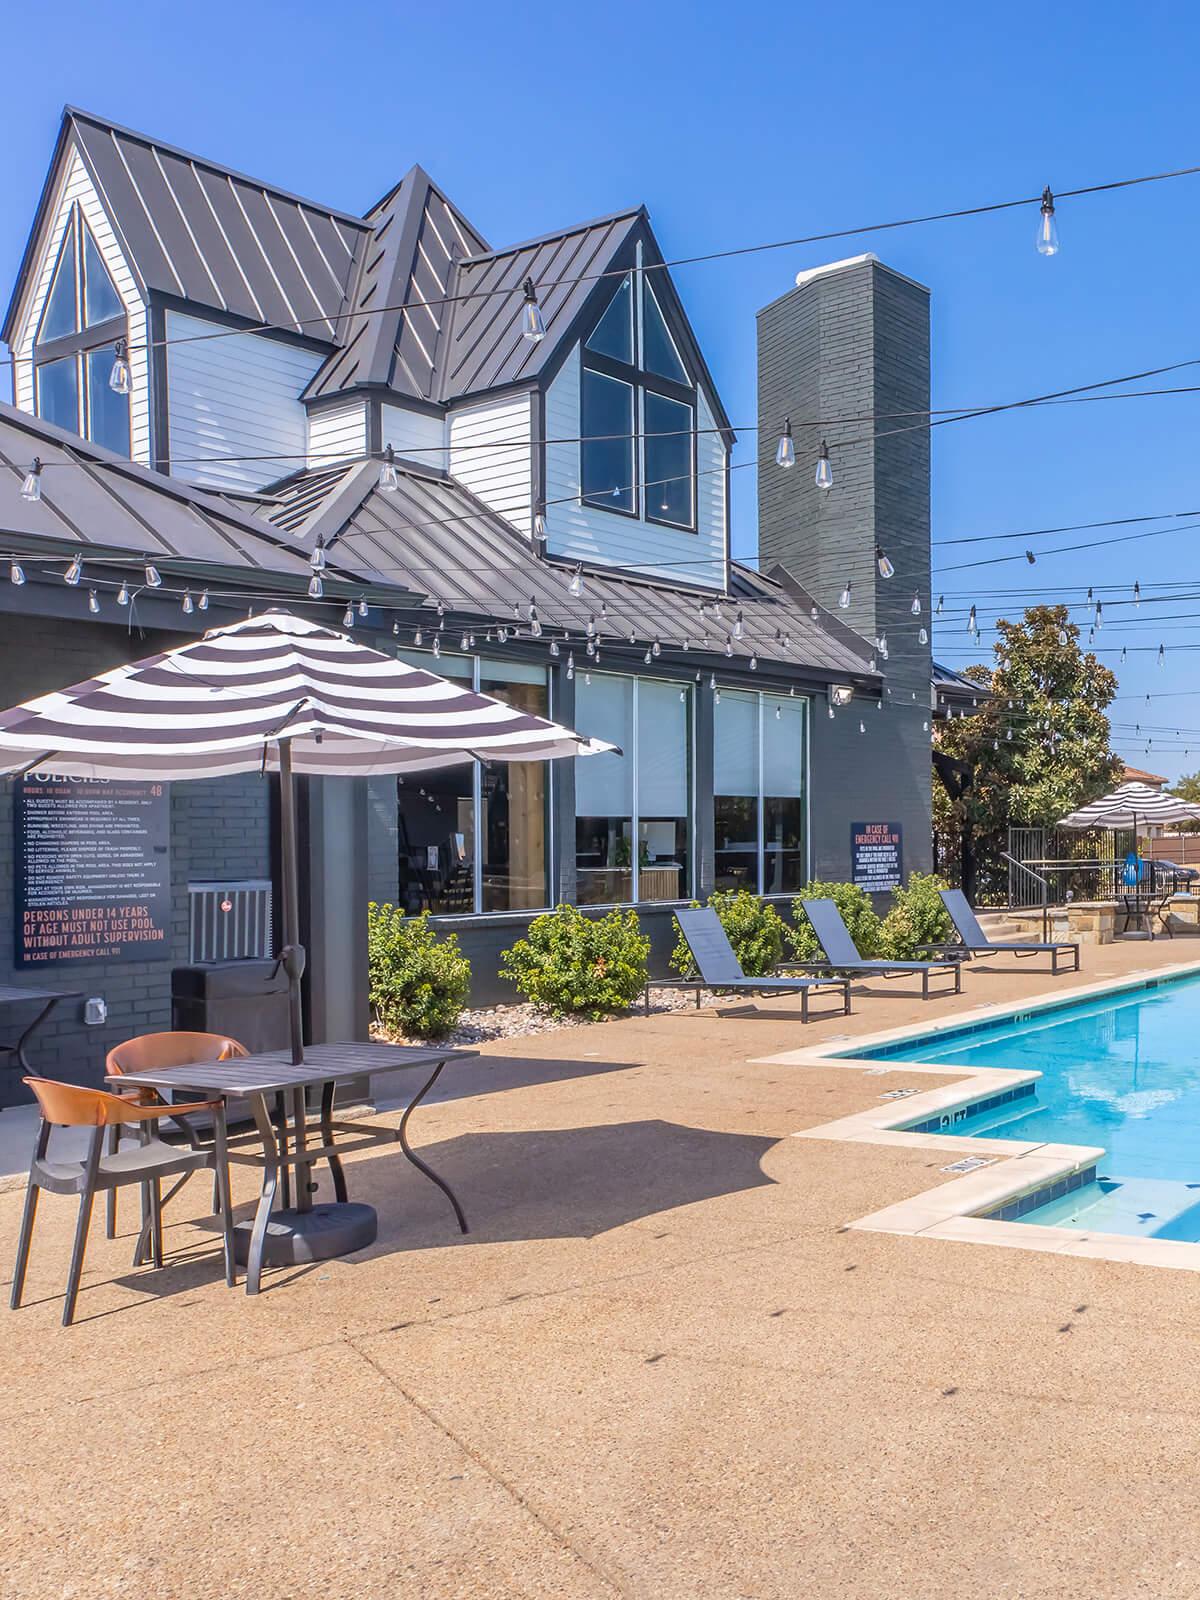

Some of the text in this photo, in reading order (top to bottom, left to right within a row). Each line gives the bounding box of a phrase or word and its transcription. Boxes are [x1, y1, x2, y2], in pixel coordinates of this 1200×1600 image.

[24, 906, 148, 922] PERSONS UNDER 14 YEARS
[24, 918, 154, 936] OF AGE MUST NOT USE POOL
[24, 928, 164, 949] WITHOUT ADULT SUPERVISION
[24, 952, 31, 961] IN
[32, 952, 48, 960] CASE
[49, 951, 58, 959] OF
[58, 948, 95, 959] EMERGENCY
[96, 948, 110, 956] CALL
